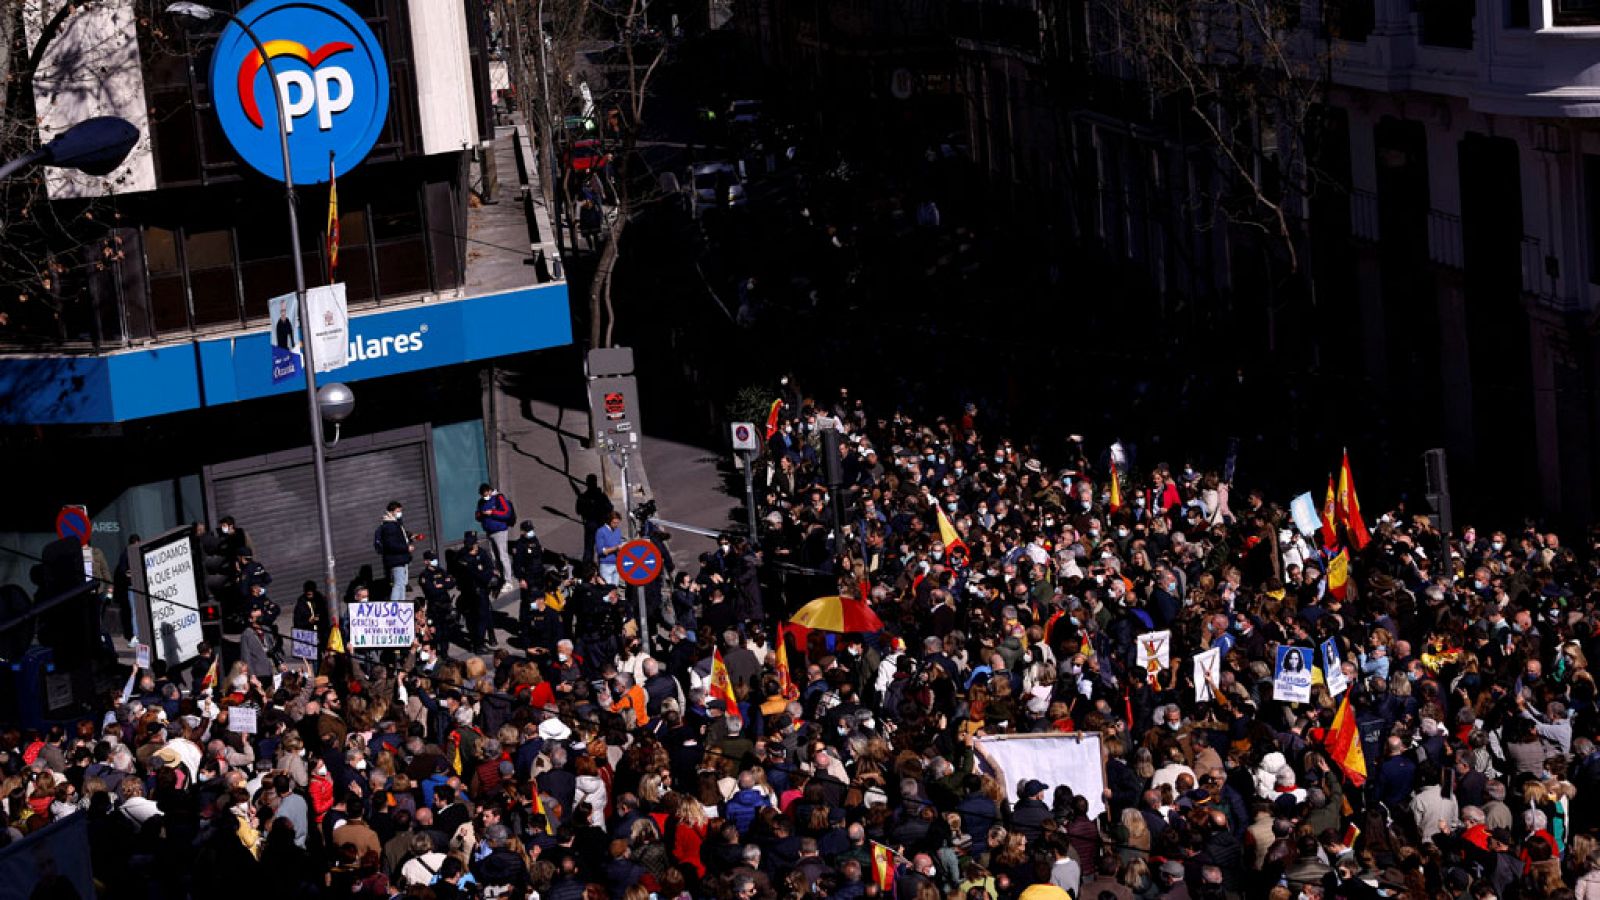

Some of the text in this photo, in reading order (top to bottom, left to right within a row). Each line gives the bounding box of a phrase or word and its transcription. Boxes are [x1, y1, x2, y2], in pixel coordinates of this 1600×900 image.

[347, 331, 423, 362] ulares
[92, 521, 120, 532] ARES
[145, 542, 189, 568] AYUDAMOS
[155, 567, 172, 584] QUE
[172, 560, 191, 578] HAYA
[357, 602, 398, 617] AYUSO
[355, 635, 366, 645] LA
